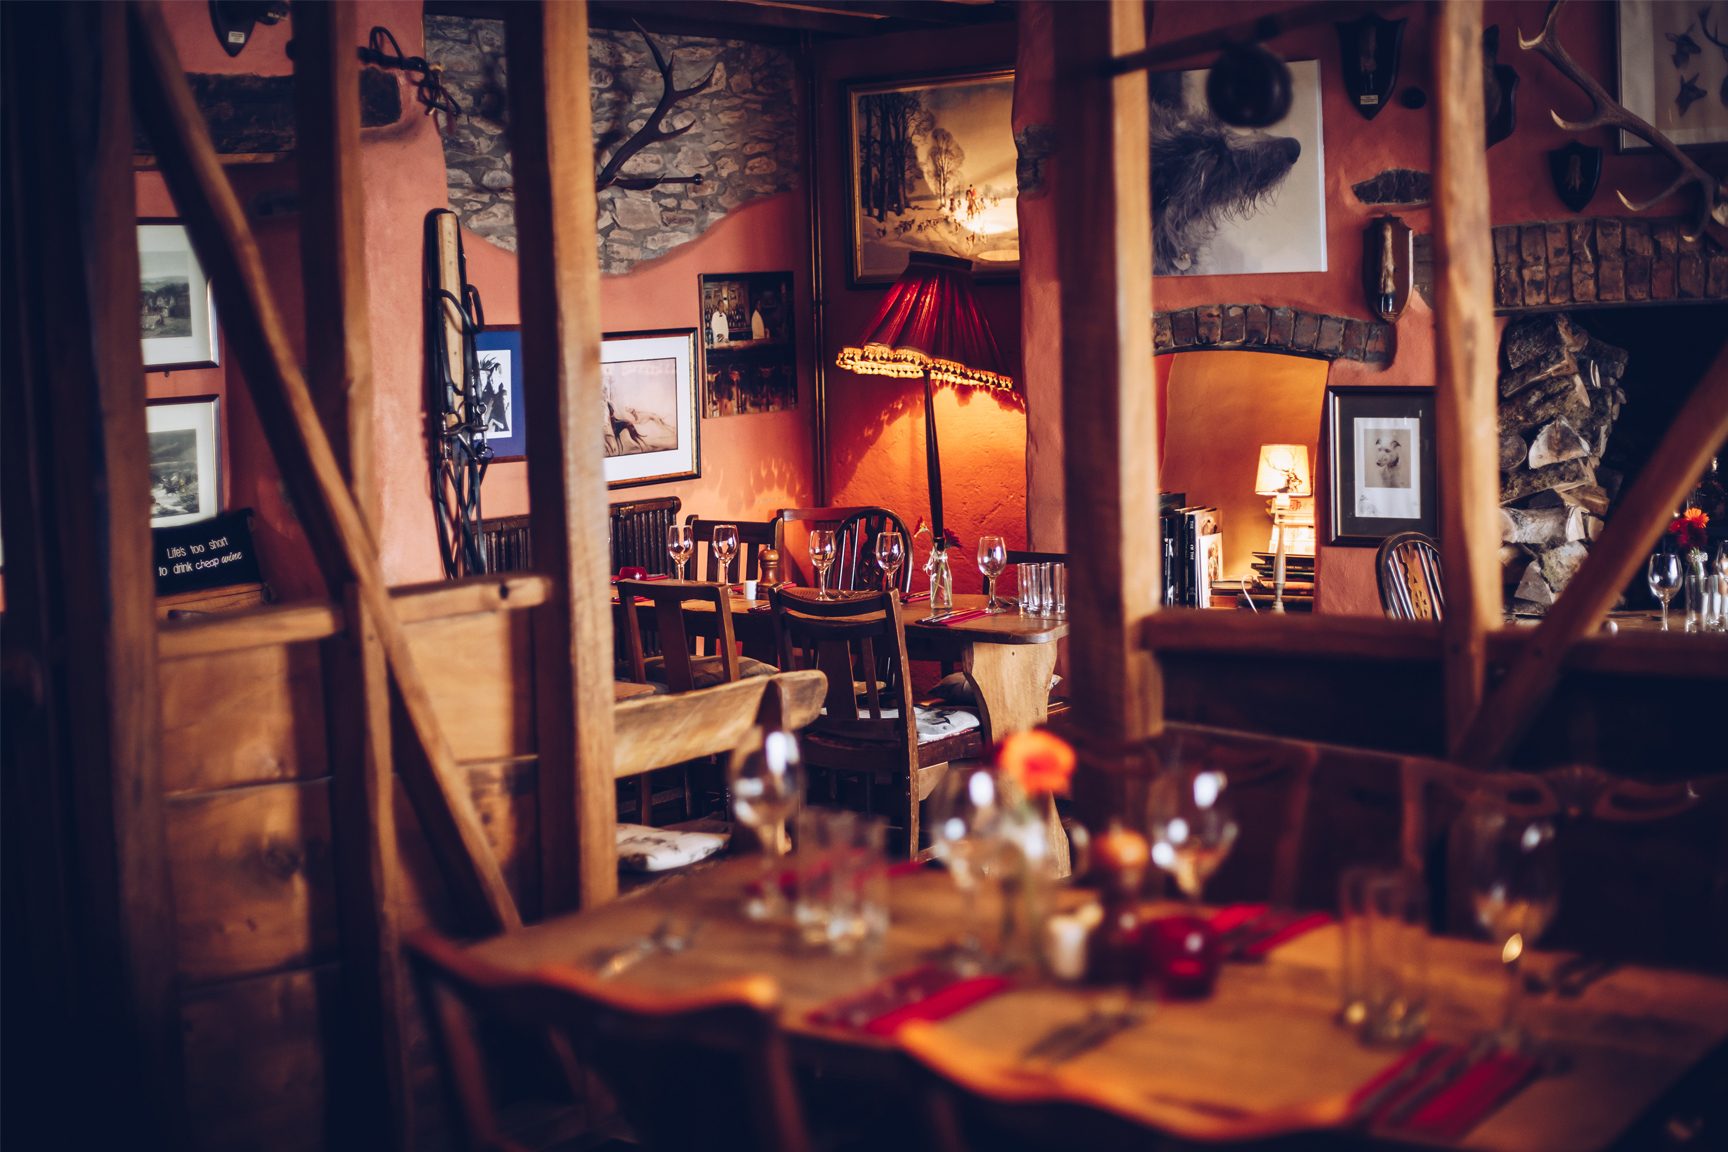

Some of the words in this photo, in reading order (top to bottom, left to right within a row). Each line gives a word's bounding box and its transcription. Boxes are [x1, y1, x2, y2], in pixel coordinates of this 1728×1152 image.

[166, 547, 187, 559] Life's
[190, 544, 205, 555] too
[208, 536, 229, 550] short
[158, 566, 168, 576] to
[173, 561, 193, 574] drink
[195, 557, 220, 569] cheap
[221, 551, 243, 563] wine
